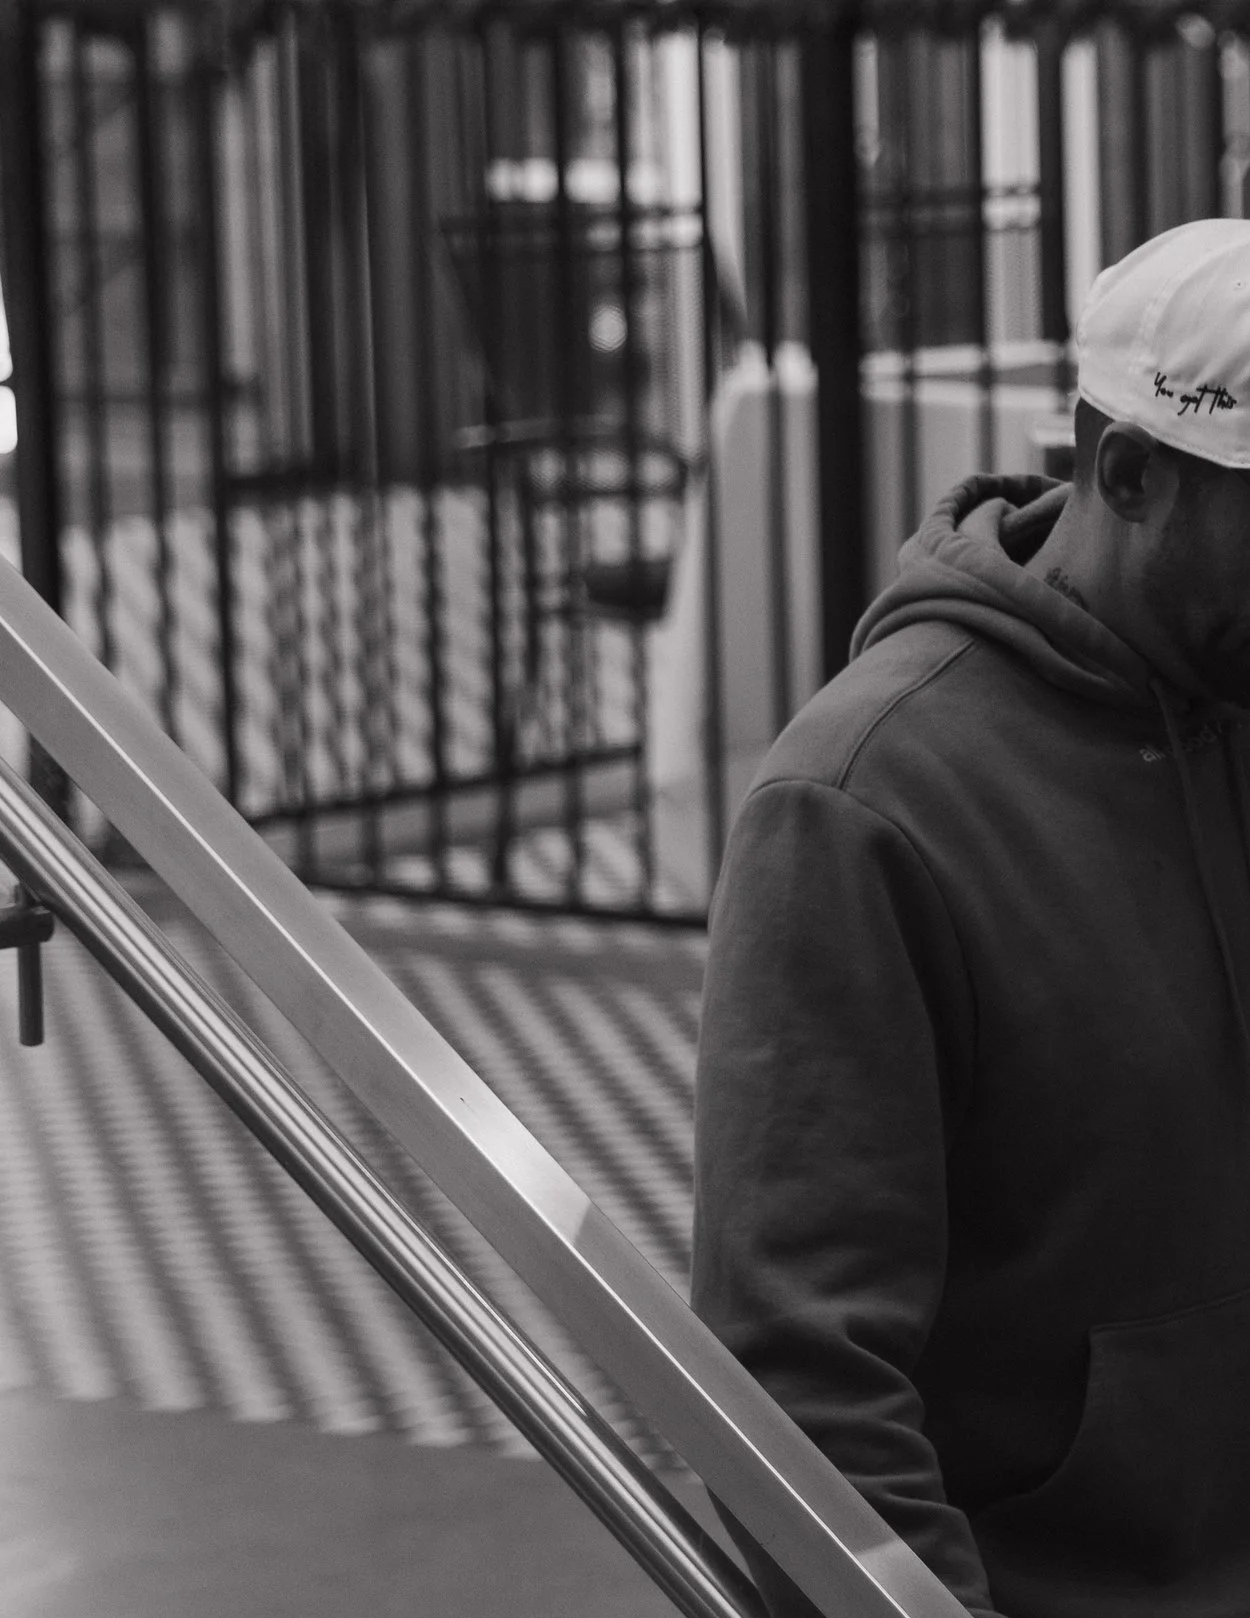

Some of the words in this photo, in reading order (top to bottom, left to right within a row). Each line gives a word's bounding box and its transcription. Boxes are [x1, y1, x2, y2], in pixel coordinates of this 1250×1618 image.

[1154, 372, 1173, 397] You
[1178, 385, 1208, 416] got
[1139, 745, 1165, 762] all
